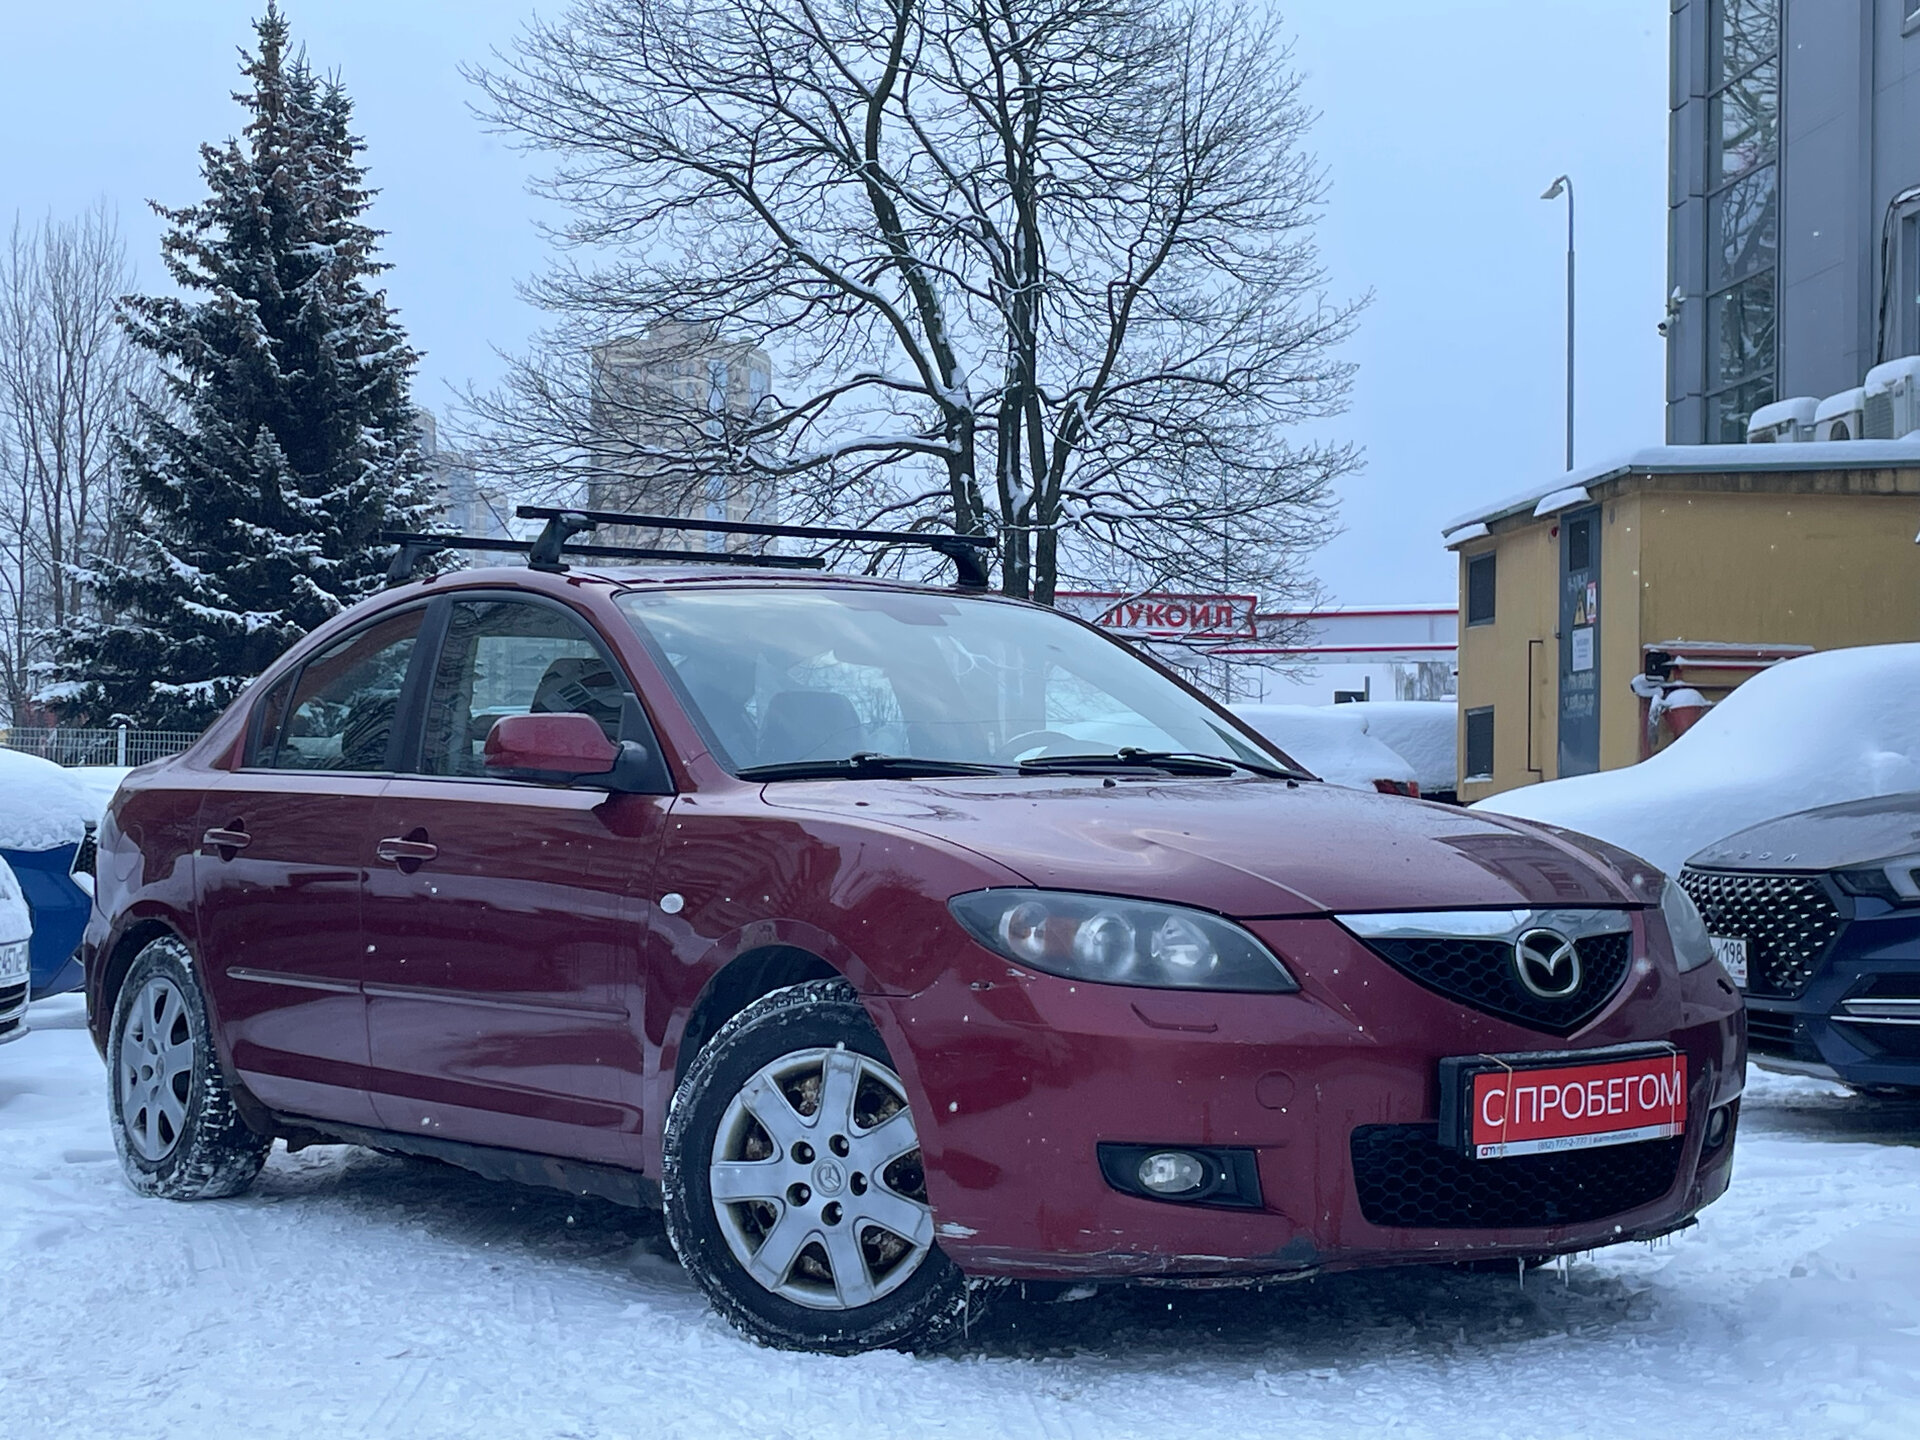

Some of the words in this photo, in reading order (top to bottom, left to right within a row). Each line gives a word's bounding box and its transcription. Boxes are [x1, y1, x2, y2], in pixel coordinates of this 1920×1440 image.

[1722, 942, 1743, 964] 198
[1482, 1089, 1505, 1127] С
[1515, 1071, 1682, 1124] ПРОБЕГОМ
